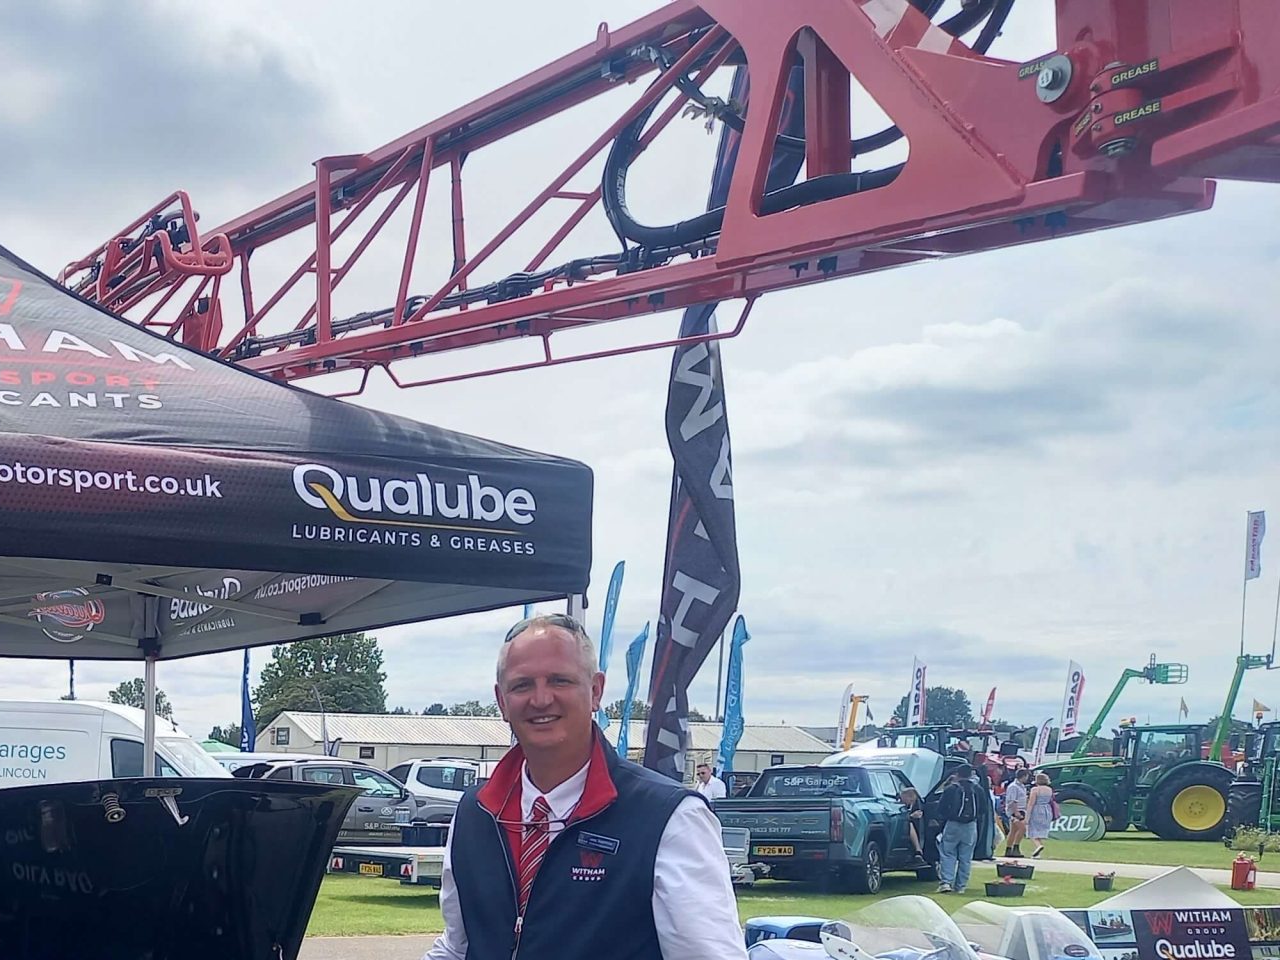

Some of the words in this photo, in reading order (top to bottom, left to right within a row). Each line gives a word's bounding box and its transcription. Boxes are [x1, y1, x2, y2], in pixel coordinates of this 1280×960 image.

[1019, 62, 1048, 78] GREAS
[1111, 61, 1158, 85] GREASE
[1114, 102, 1160, 125] GREASE
[292, 463, 537, 526] Qualube
[292, 524, 421, 546] LUBRICANTS
[430, 534, 441, 548] &
[450, 536, 536, 555] GREASES
[784, 777, 804, 787] S&P
[805, 777, 846, 788] Garages
[757, 847, 777, 855] FY26
[572, 867, 605, 875] WITHAM
[1175, 911, 1232, 922] WITHAM
[1156, 939, 1236, 960] Qualube
